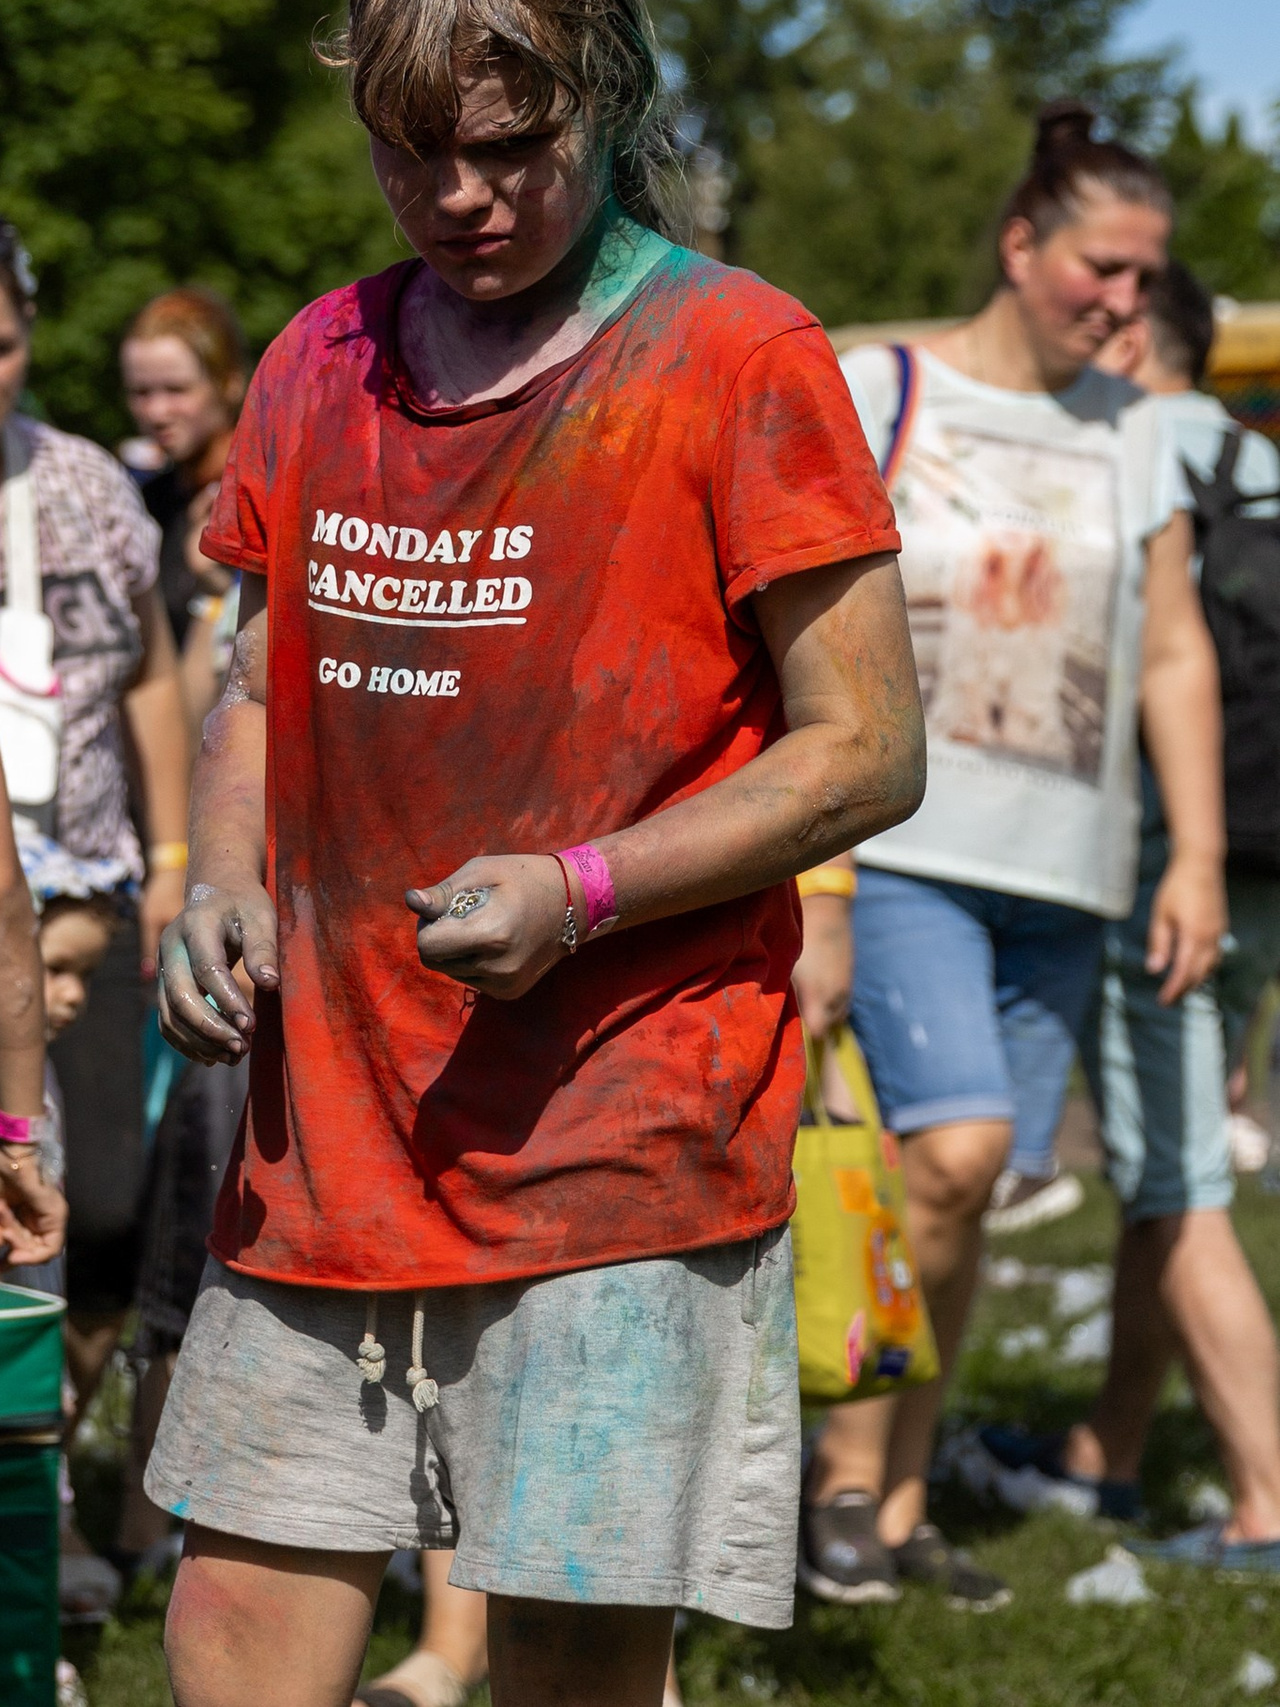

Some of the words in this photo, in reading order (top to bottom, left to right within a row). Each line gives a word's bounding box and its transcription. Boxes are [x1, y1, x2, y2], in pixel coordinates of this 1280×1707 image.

[312, 509, 482, 564] MONDAY
[490, 525, 534, 561] IS
[308, 559, 533, 614] CANCELLED
[319, 657, 361, 688] GO
[367, 666, 461, 697] HOME
